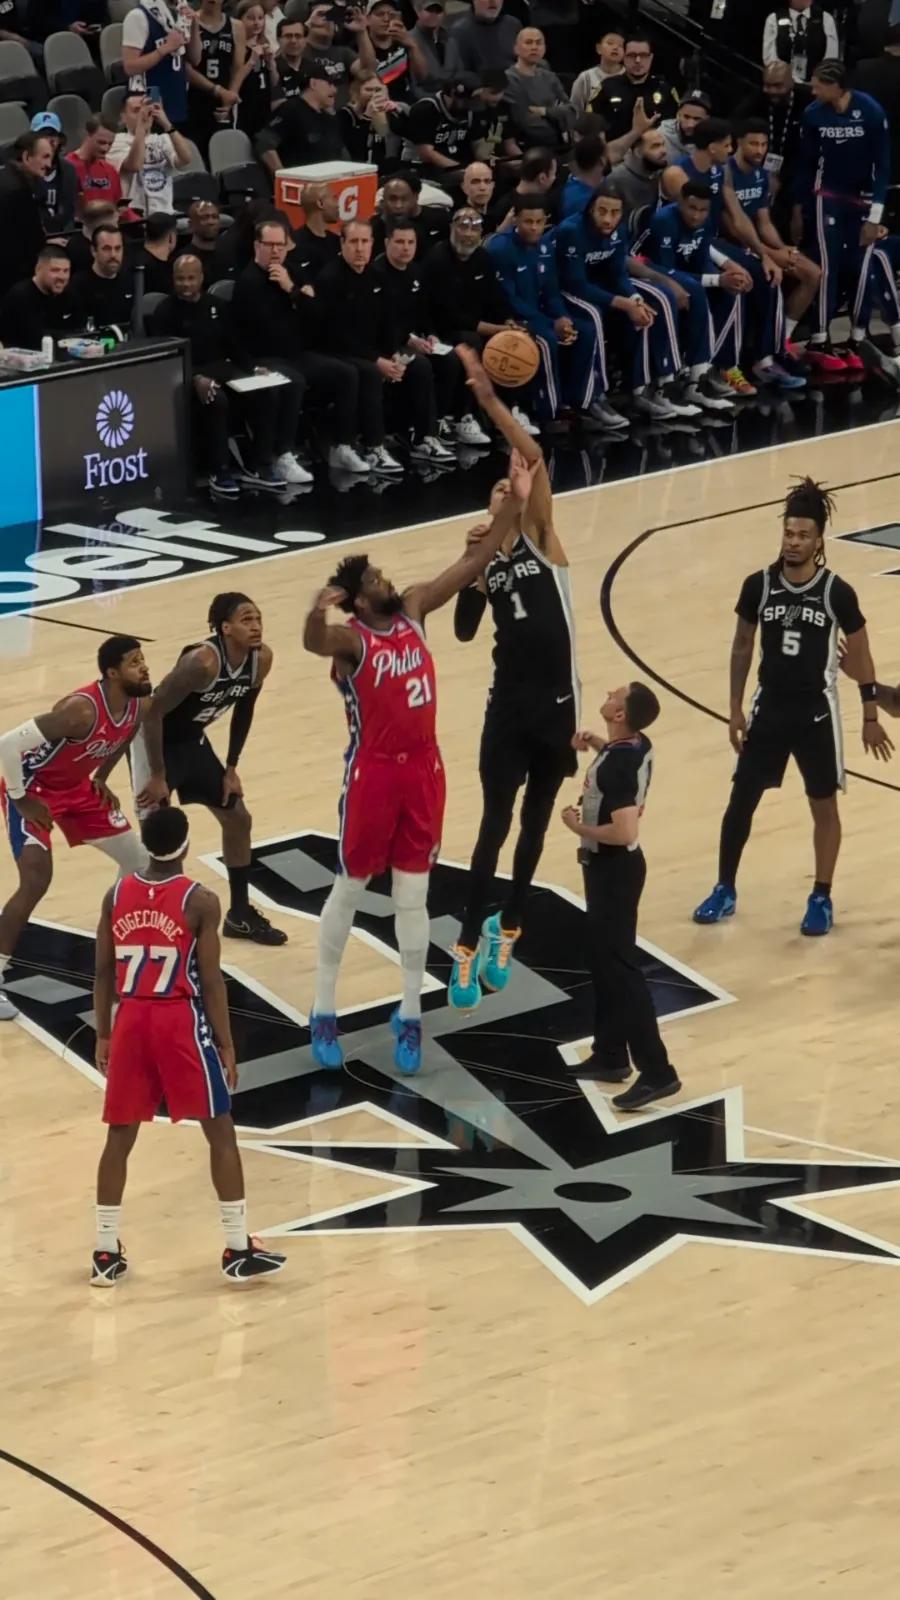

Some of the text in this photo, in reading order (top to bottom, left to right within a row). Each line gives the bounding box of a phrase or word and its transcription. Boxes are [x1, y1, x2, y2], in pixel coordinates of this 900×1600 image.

[206, 58, 219, 79] 5
[259, 72, 266, 89] 1
[818, 126, 865, 138] 76ERS
[338, 185, 359, 221] G
[83, 447, 149, 490] Frost
[510, 591, 528, 620] 1
[763, 604, 826, 628] SPURS
[781, 629, 801, 656] 5
[372, 643, 423, 688] Phila
[405, 673, 432, 709] 21
[112, 909, 184, 942] EDGECOMBE
[114, 944, 181, 996] 77
